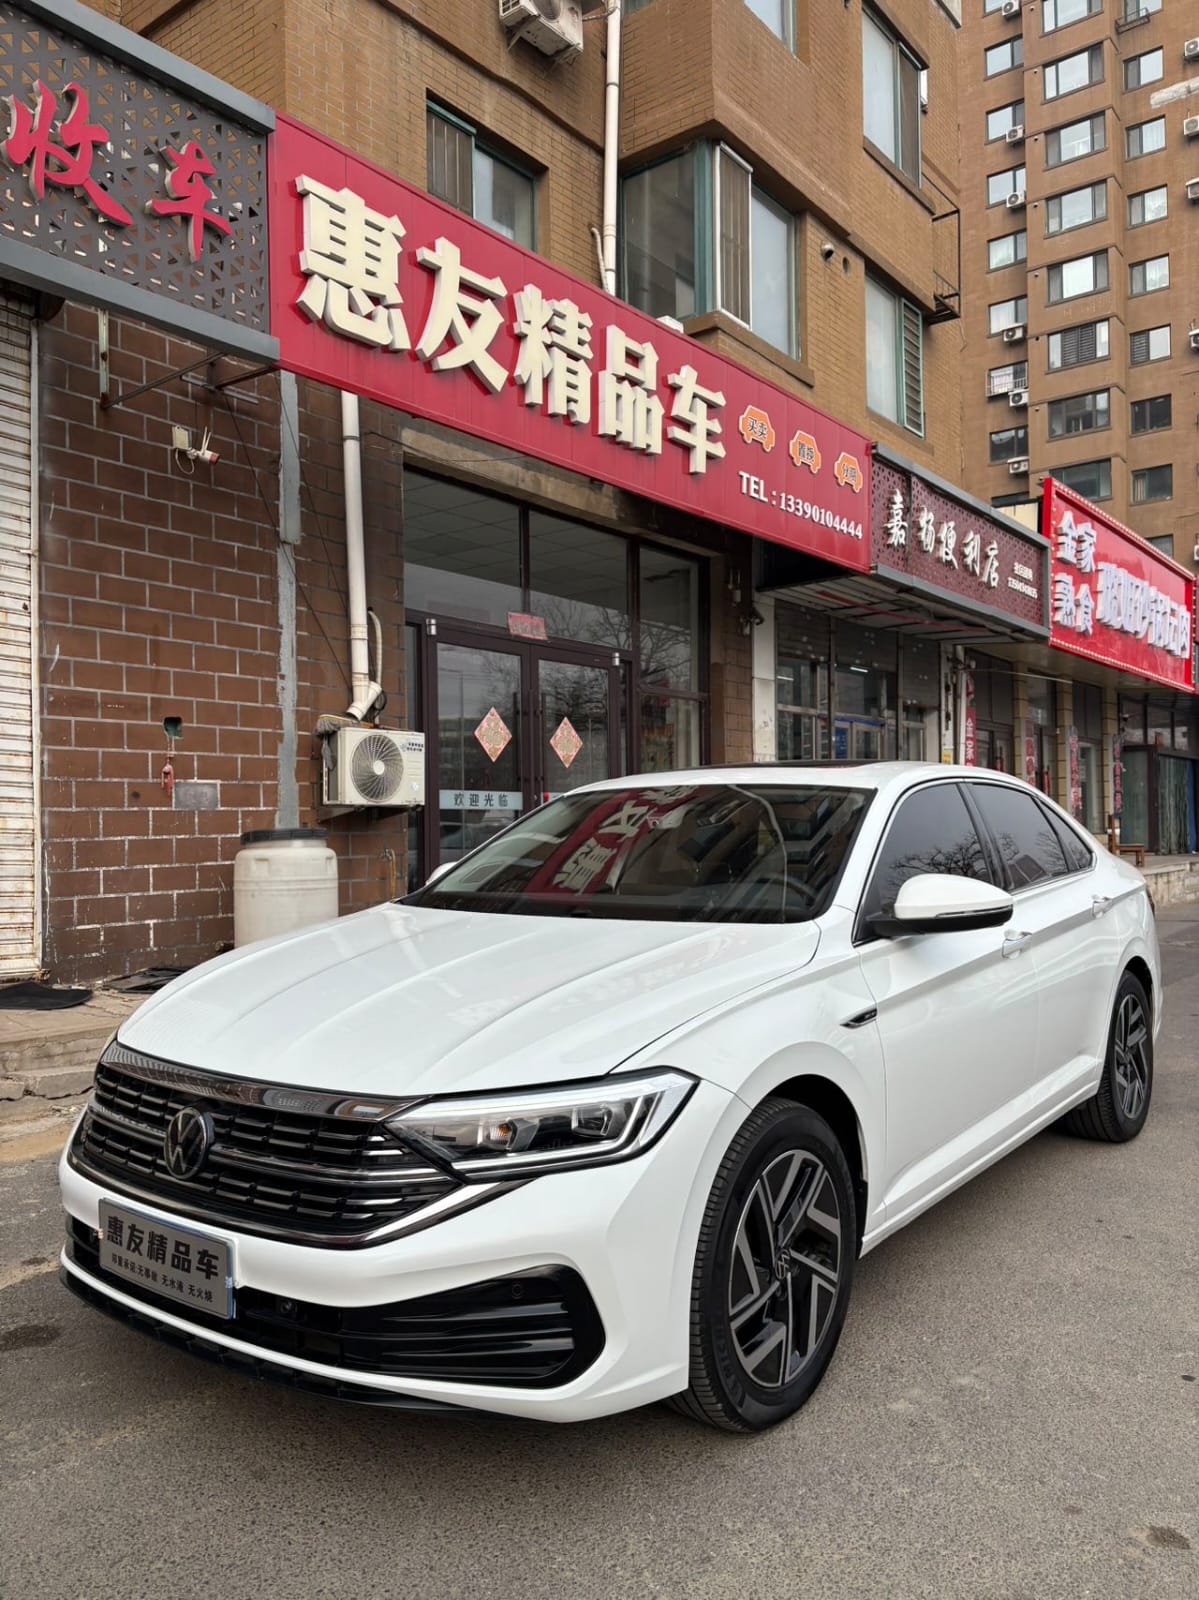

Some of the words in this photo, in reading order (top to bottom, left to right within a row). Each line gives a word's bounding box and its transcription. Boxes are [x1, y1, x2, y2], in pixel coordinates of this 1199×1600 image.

[1, 79, 232, 263] 收车
[295, 173, 727, 474] 惠友精品车
[748, 417, 767, 439] 买卖
[780, 492, 862, 539] 13390104444
[1057, 511, 1097, 572] 金家
[454, 793, 508, 807] 欢迎光临
[107, 1215, 219, 1280] 惠友精品车
